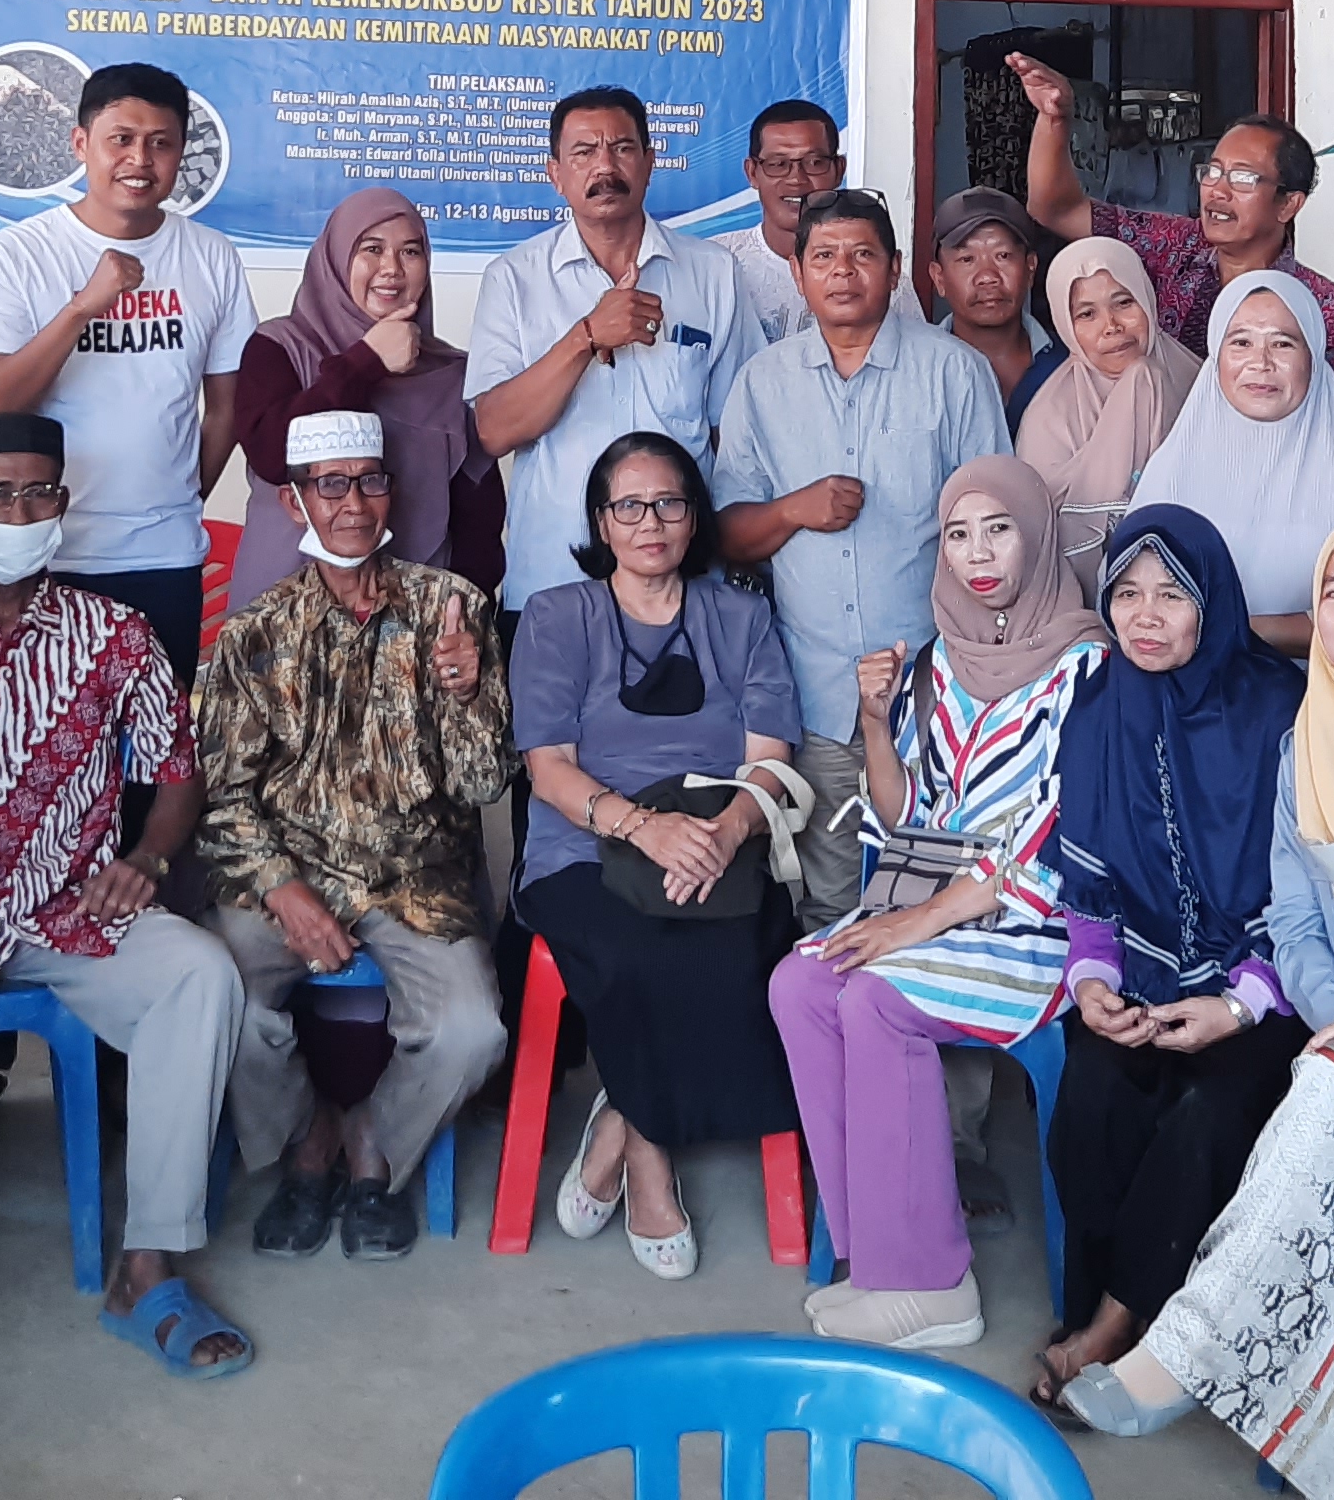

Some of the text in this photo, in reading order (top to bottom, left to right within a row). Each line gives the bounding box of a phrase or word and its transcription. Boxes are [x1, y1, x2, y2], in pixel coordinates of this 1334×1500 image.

[66, 8, 724, 58] SKEMA PEMBERDAYAAN KEMITRAAN MASYARAKAT (PKM)
[428, 75, 455, 90] TIM
[461, 75, 545, 93] PELAKSANA
[272, 90, 314, 104] Ketua:
[317, 91, 356, 107] Hijrah
[506, 97, 560, 112] (Univers
[645, 101, 704, 118] Sulawesi)
[276, 108, 334, 124] Anggota:
[338, 110, 360, 124] Dwi
[501, 115, 551, 130] (Univers
[647, 120, 699, 136] ulawesi)
[333, 128, 366, 142] Muh.
[369, 129, 413, 144] Arman,
[477, 132, 550, 147] (Universitas
[285, 144, 362, 159] Mahasiswa:
[365, 146, 412, 161] Edward
[343, 164, 360, 178] Tri
[364, 165, 394, 178] Dewi
[399, 166, 435, 180] Utami
[439, 166, 514, 183] (Universitas
[445, 203, 488, 219] 12-13
[492, 205, 550, 222] Agustus
[554, 207, 574, 221] 20
[74, 288, 183, 321] RDEKA
[77, 318, 184, 353] BELAJAR
